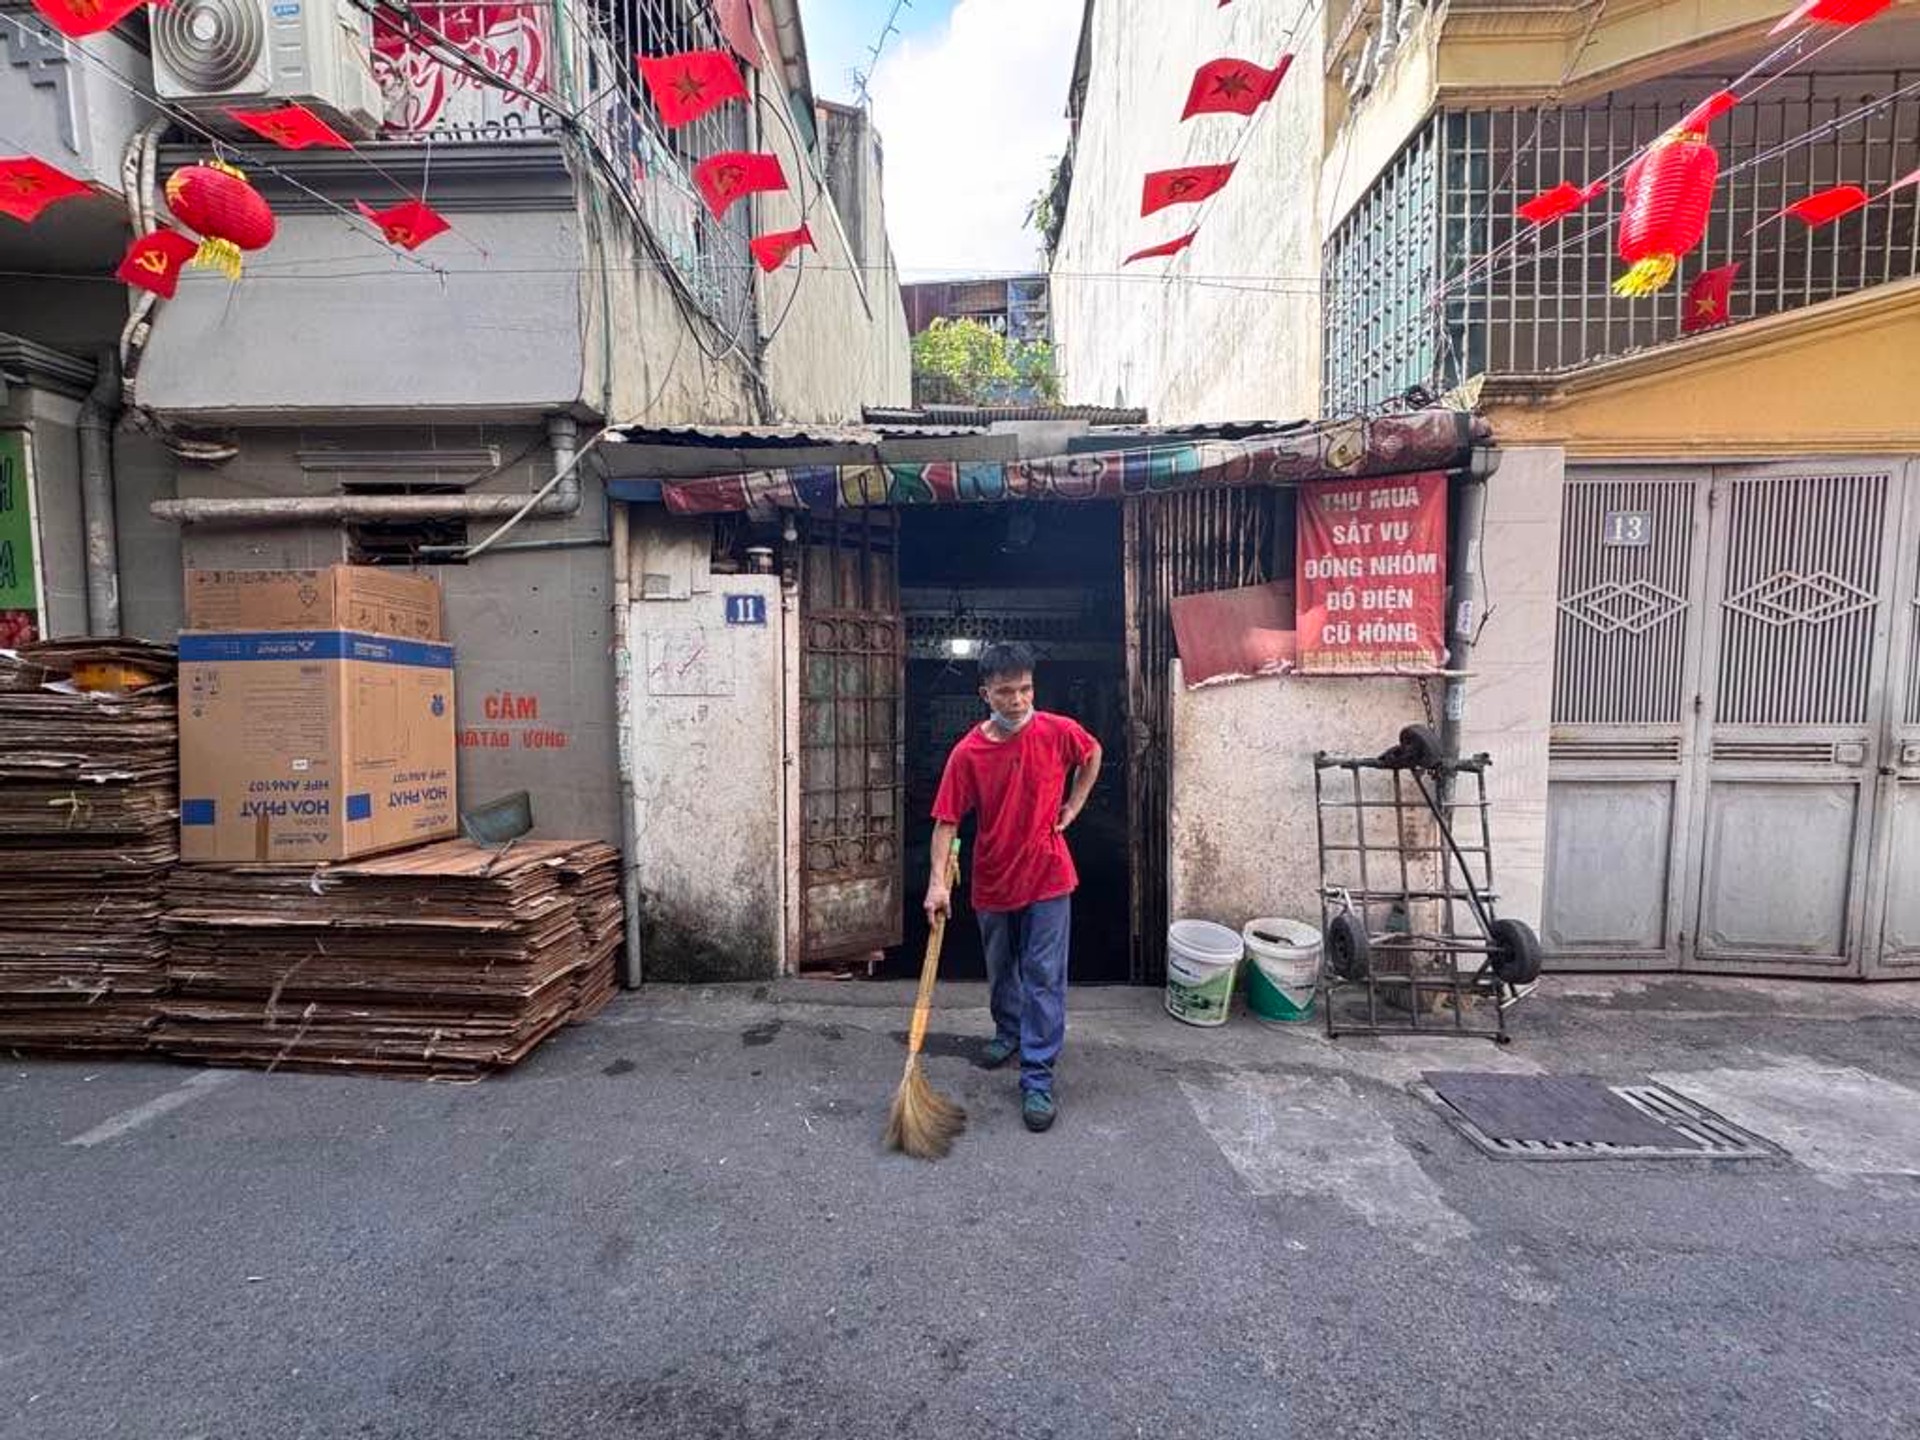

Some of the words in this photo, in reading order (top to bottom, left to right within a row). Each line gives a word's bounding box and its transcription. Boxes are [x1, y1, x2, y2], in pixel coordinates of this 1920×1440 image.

[1322, 492, 1362, 511] THU
[1370, 486, 1419, 509] MUA
[1380, 521, 1410, 545] VỤ
[1615, 515, 1642, 540] 13
[1370, 549, 1437, 576] NHÔM
[736, 598, 756, 622] 11
[1361, 585, 1413, 614] ĐIỆN
[1322, 620, 1351, 644] CŨ
